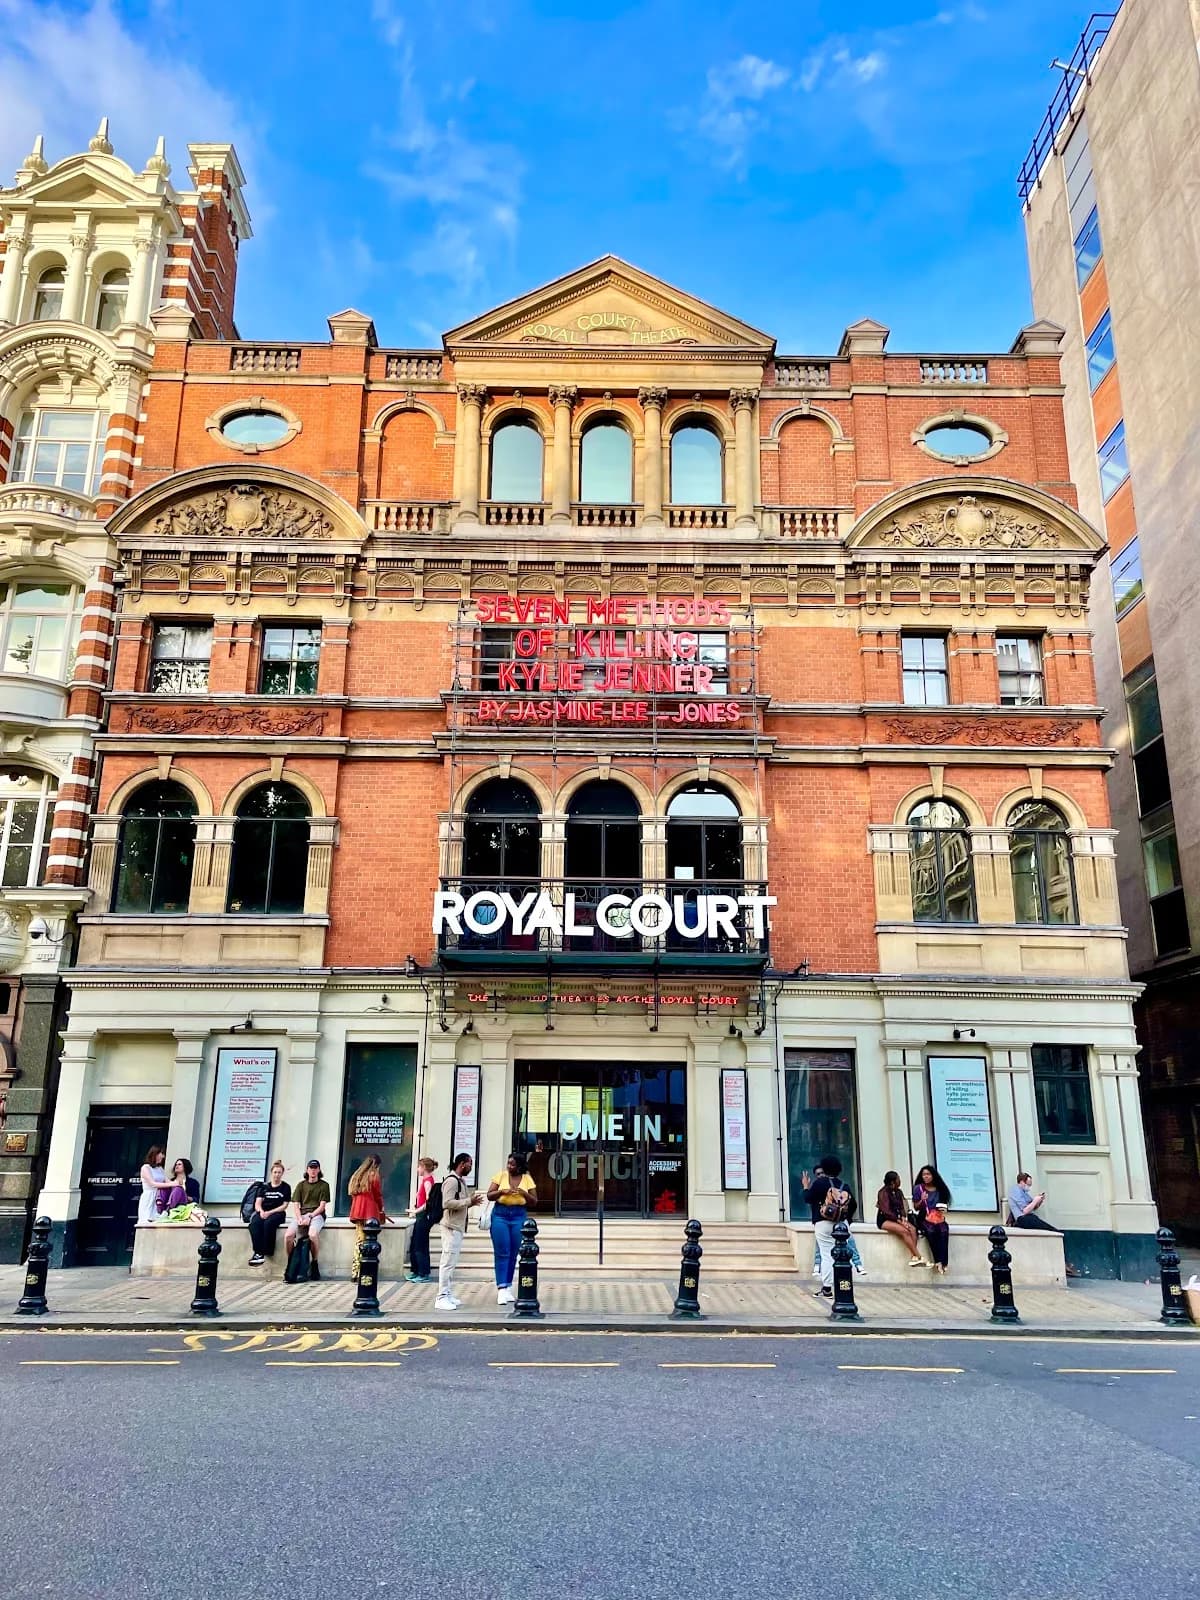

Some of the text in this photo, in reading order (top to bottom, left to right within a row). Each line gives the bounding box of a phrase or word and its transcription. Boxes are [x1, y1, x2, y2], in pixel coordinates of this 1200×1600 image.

[523, 323, 579, 343] ROYAL
[577, 313, 640, 331] COURT
[475, 596, 732, 624] SEVEN METHODS
[515, 630, 696, 658] OF KILLING
[498, 662, 713, 692] KYLIE JENNER
[478, 700, 506, 720] BY
[510, 701, 603, 721] JASMINE
[611, 702, 648, 721] LEE
[433, 890, 778, 939] ROYAL COURT
[467, 993, 489, 1002] THE
[660, 996, 695, 1004] ROYAL
[701, 996, 738, 1005] COURT
[634, 1114, 661, 1141] IN
[148, 1333, 438, 1354] STAND
